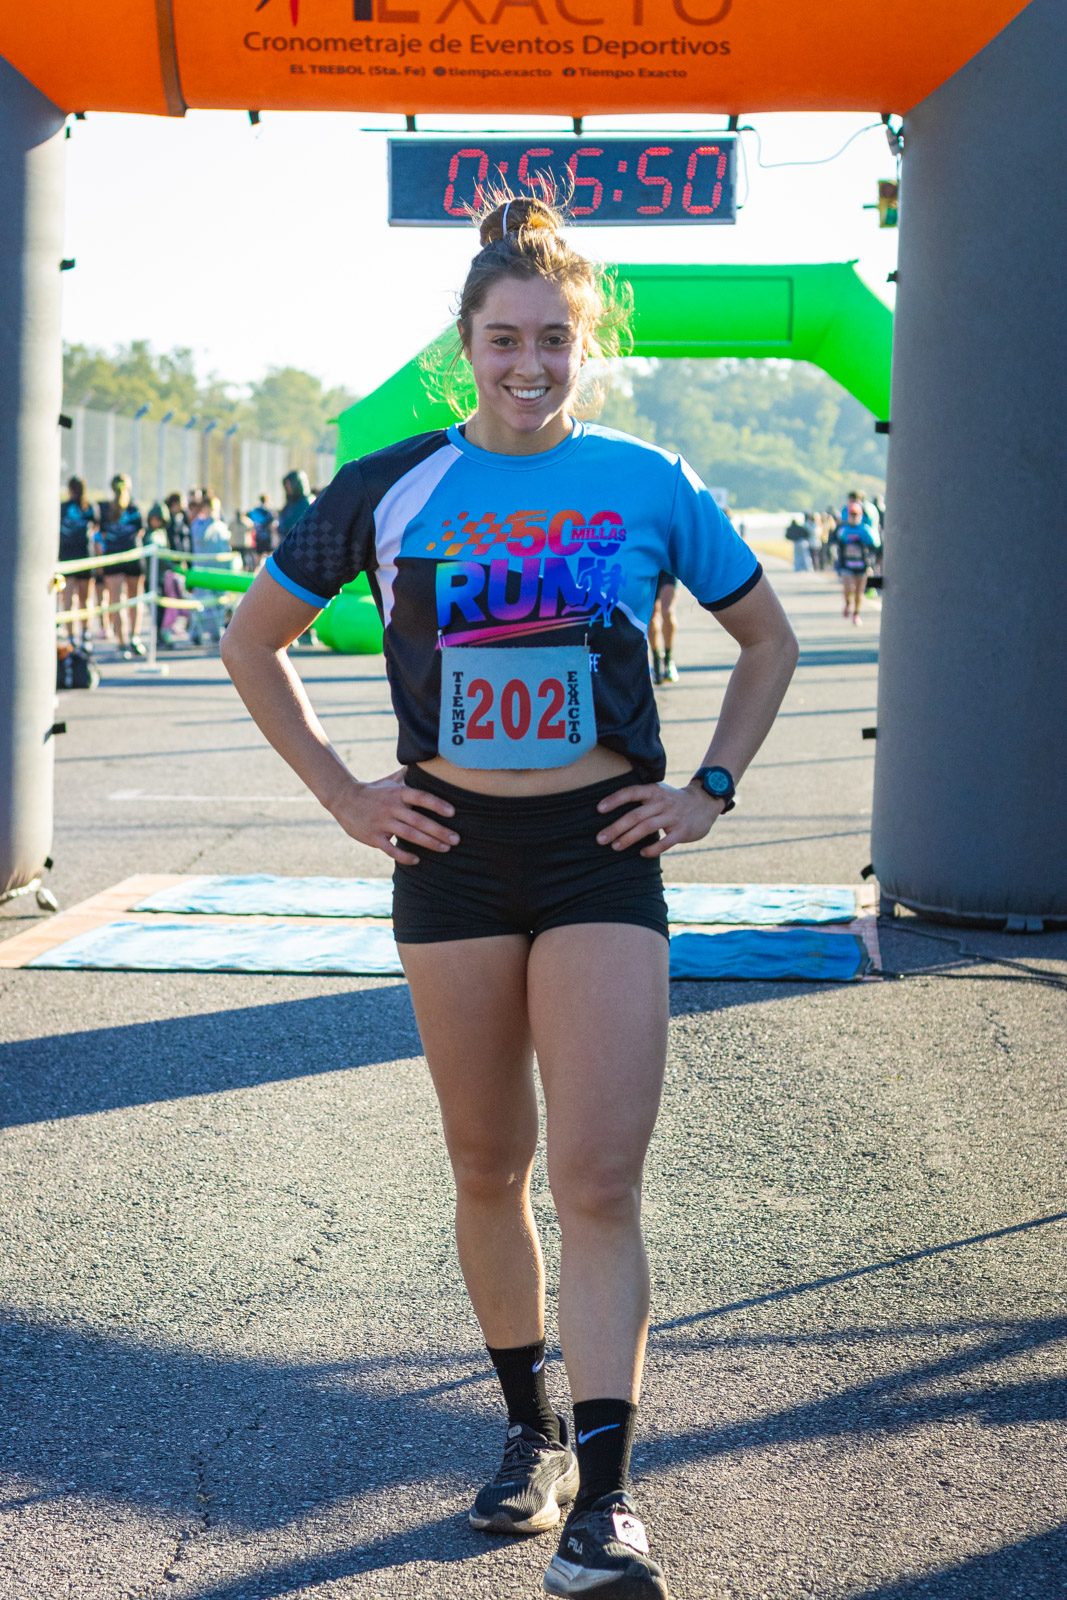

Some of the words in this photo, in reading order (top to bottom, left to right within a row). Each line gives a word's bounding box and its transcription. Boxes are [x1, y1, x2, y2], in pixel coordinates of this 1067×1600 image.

[243, 31, 422, 58] Cronometraje
[429, 33, 463, 54] de
[470, 34, 576, 55] Eventos
[583, 35, 732, 59] Deportivos
[290, 64, 307, 74] EL
[310, 64, 365, 75] TREBOL
[368, 65, 401, 76] (Sta.
[404, 65, 426, 77] Fe)
[449, 66, 552, 78] tiempo.exacto
[579, 67, 635, 79] Tiempo
[638, 67, 688, 78] Exacto
[571, 527, 627, 542] MILLAS
[435, 557, 598, 628] RUN
[451, 671, 466, 746] TIEMPO
[465, 677, 567, 741] 202
[566, 671, 582, 745] EXACTO
[567, 1536, 584, 1556] FILA
